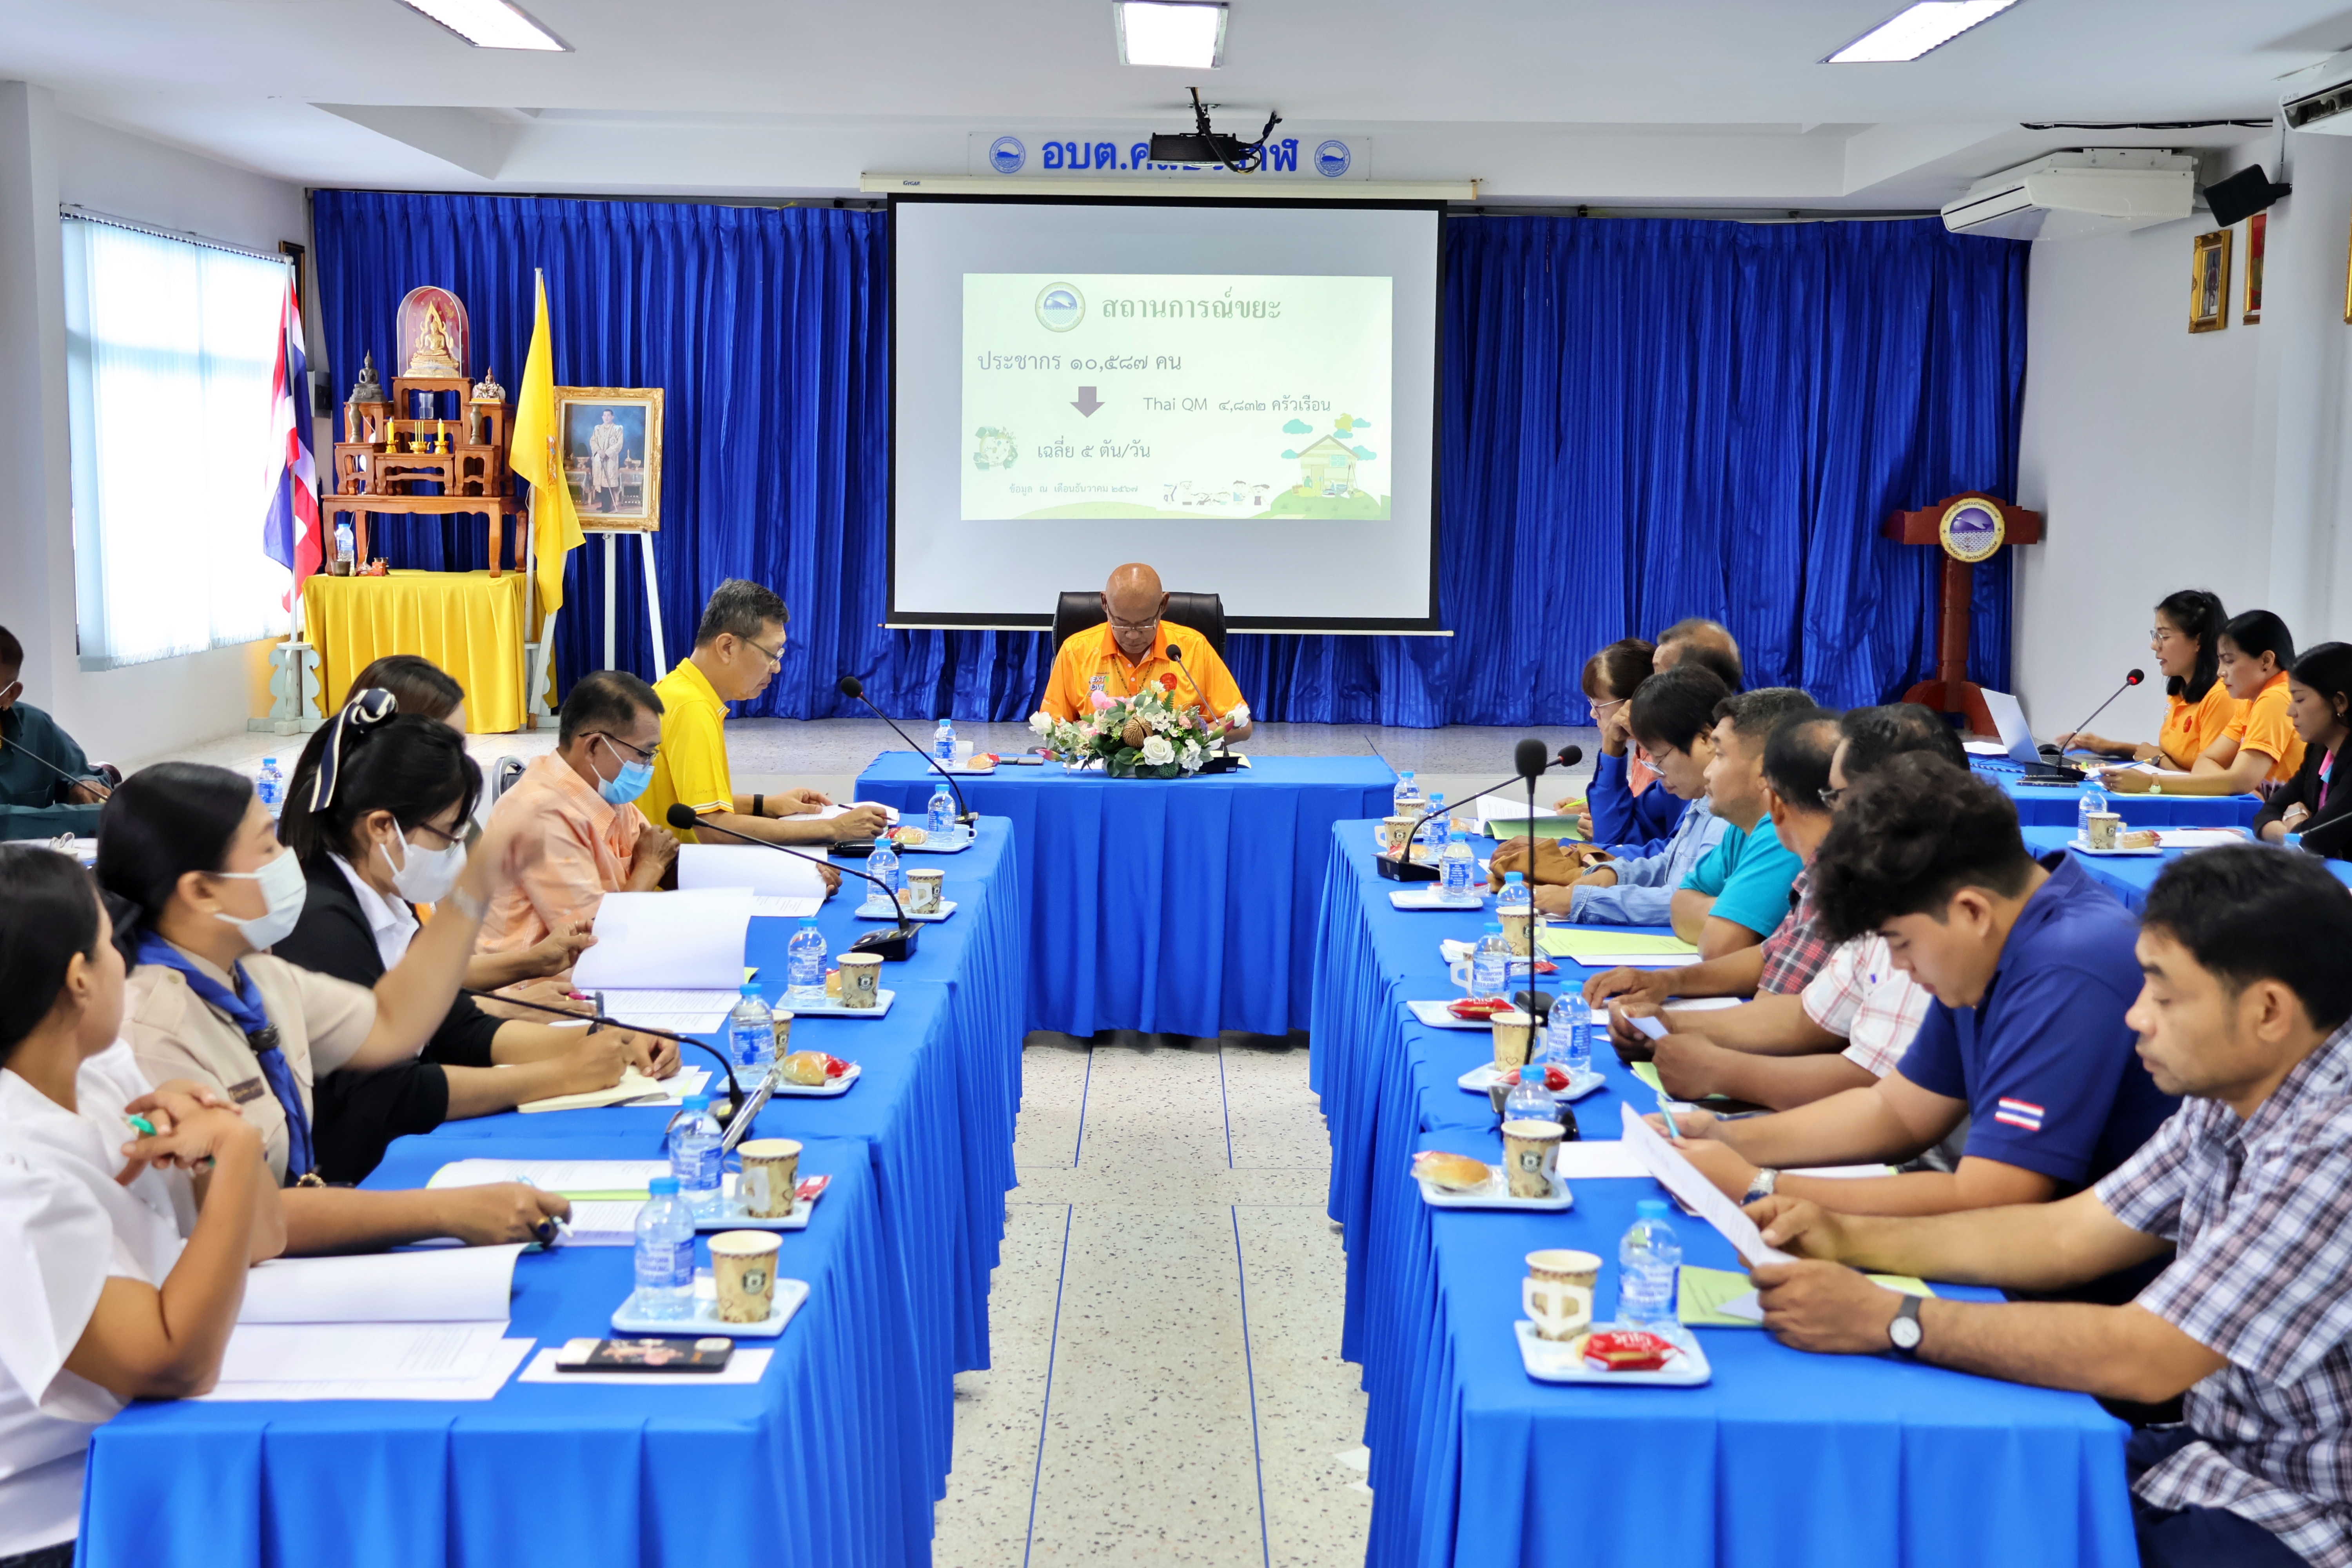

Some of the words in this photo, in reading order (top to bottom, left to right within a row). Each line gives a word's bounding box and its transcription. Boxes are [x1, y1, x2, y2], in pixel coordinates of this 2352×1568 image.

[1102, 286, 1281, 319] สถานการณ์ขยะ
[977, 350, 1061, 370] ประชากร
[1070, 355, 1148, 373] ๑๐,๕๘๗
[1156, 355, 1181, 370] คน
[1143, 397, 1176, 411] Thai
[1181, 397, 1207, 412] QM
[1218, 400, 1266, 413] ๔,๘๓๒
[1272, 394, 1331, 412] ครัวเรือน
[1038, 435, 1074, 458] เฉลี่ย
[1081, 445, 1094, 458] ๕
[1100, 439, 1151, 458] ตัน/วัน
[1009, 483, 1033, 496] ข้อมูล
[1054, 482, 1108, 493] เดือนธันวาคม
